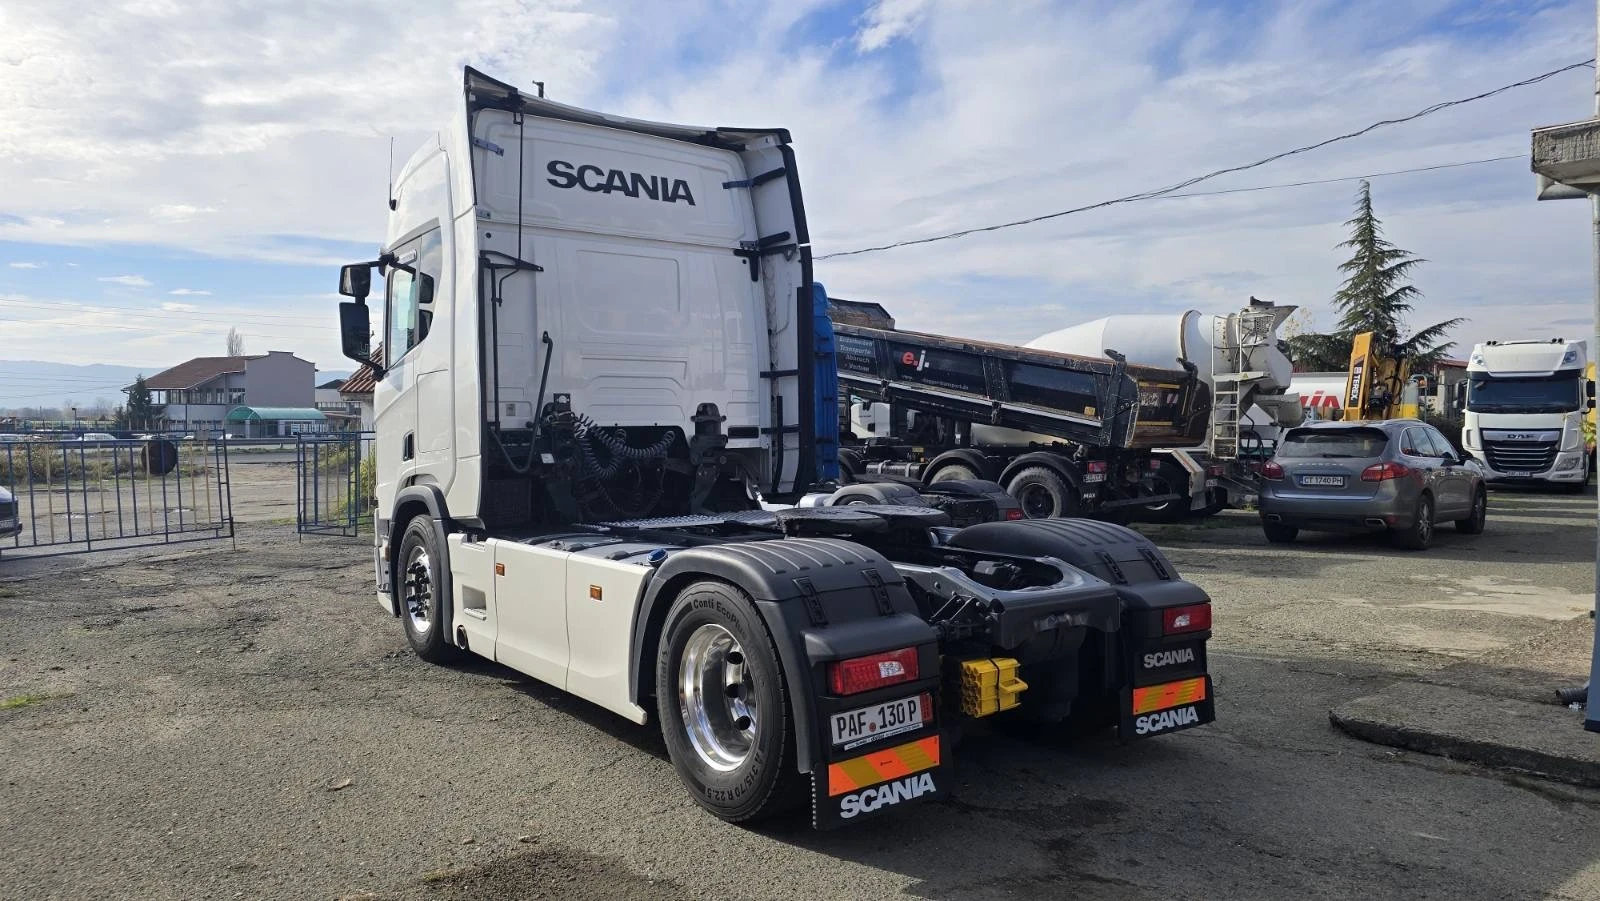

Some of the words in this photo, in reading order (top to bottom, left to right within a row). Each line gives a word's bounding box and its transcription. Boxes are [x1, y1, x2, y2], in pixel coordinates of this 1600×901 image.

[547, 160, 696, 206] SCANIA
[1351, 374, 1361, 401] TEREX
[1315, 477, 1331, 485] 1740
[693, 599, 714, 609] Conti
[1144, 648, 1194, 668] SCANIA
[836, 711, 867, 739] PAF
[878, 703, 906, 729] 130
[907, 699, 917, 721] P
[1136, 706, 1199, 735] SCANIA
[707, 788, 726, 800] 22.5
[727, 789, 734, 800] R
[840, 772, 937, 819] SCANIA
